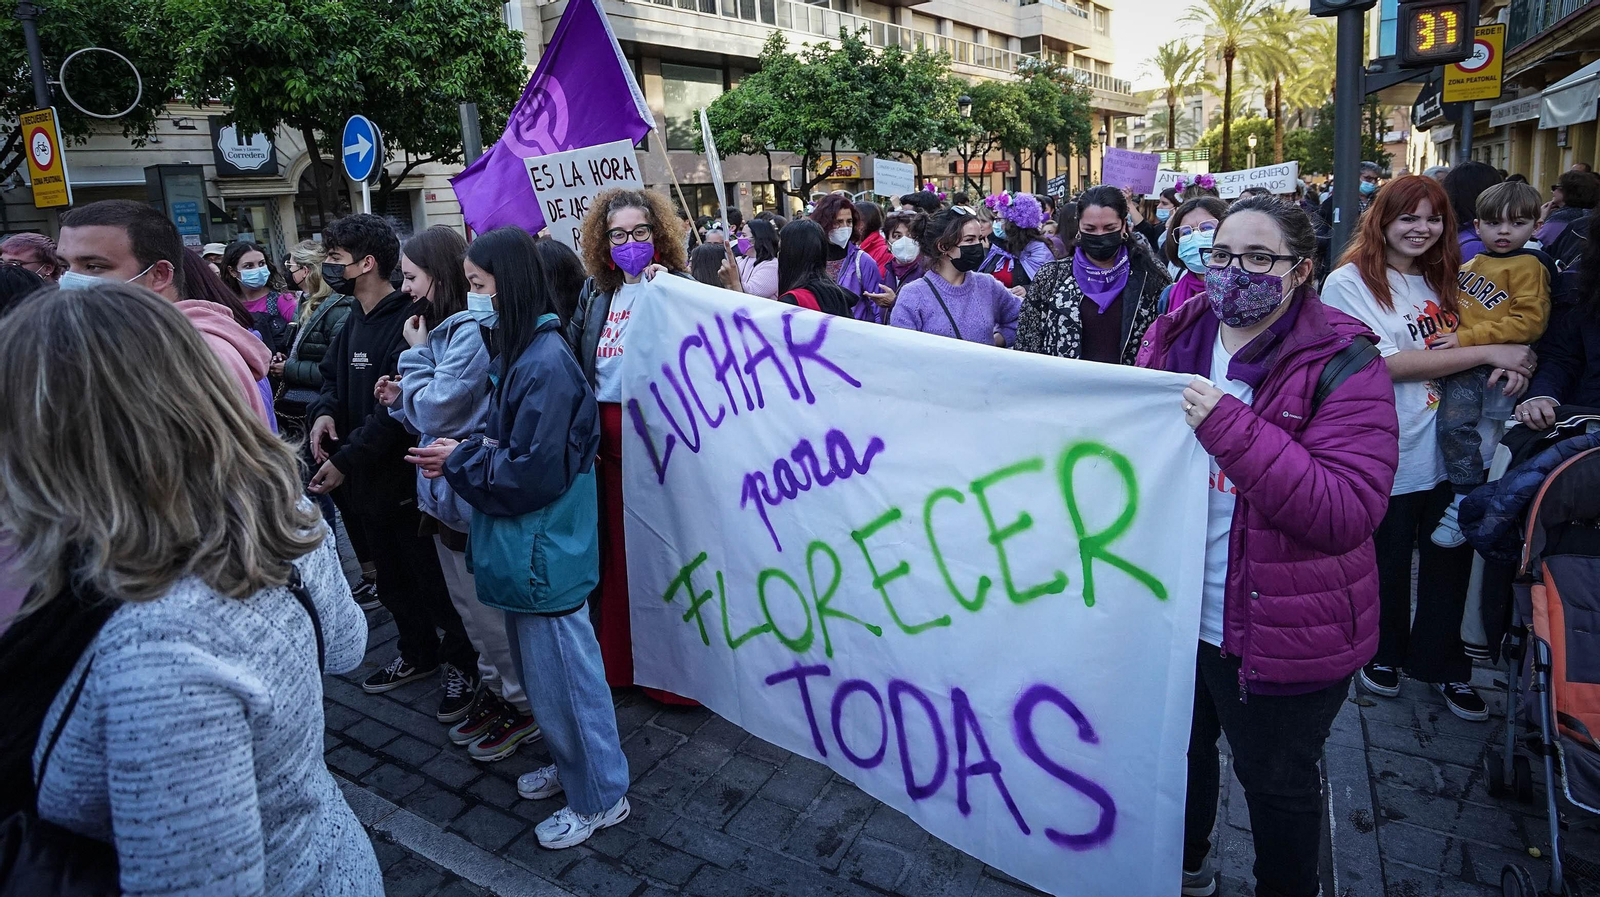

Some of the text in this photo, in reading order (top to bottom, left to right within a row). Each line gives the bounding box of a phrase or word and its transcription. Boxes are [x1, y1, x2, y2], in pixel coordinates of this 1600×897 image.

[1418, 11, 1457, 51] 37
[1475, 27, 1496, 37] ERDE
[1448, 75, 1497, 86] ZONA PEATONAL
[227, 151, 266, 159] Corredera
[530, 156, 637, 192] ES LA HORA
[1224, 174, 1245, 183] SER
[1250, 166, 1290, 180] GENERO
[1220, 186, 1234, 194] ES
[547, 198, 567, 223] DE
[1333, 207, 1341, 223] 1
[628, 308, 862, 485] LUCHAR
[739, 428, 886, 553] para
[663, 441, 1169, 659] FLORECER
[765, 660, 1121, 855] TODAS
